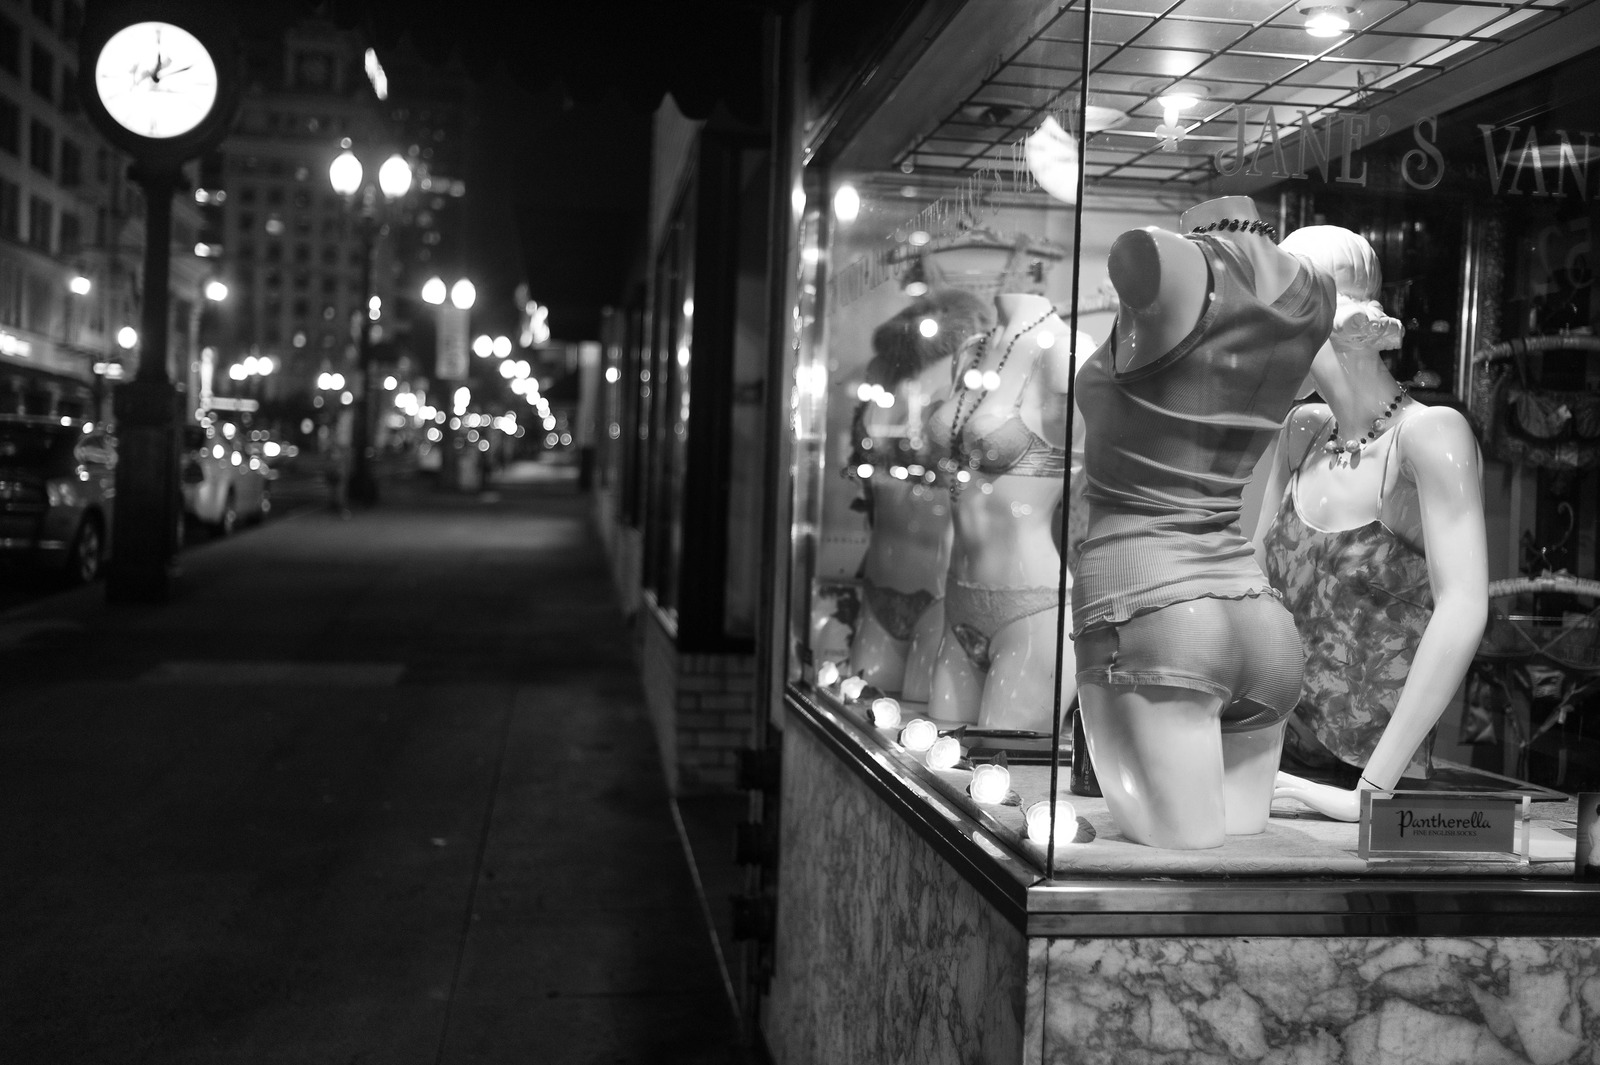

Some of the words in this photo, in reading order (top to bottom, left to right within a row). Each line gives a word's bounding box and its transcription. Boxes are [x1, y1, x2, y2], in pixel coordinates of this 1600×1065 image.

[1214, 104, 1445, 190] JANE'S
[1477, 123, 1600, 201] VAN
[1395, 810, 1491, 838] Pantherella
[1428, 829, 1456, 837] ENGLISH
[1456, 829, 1477, 837] SOCKS
